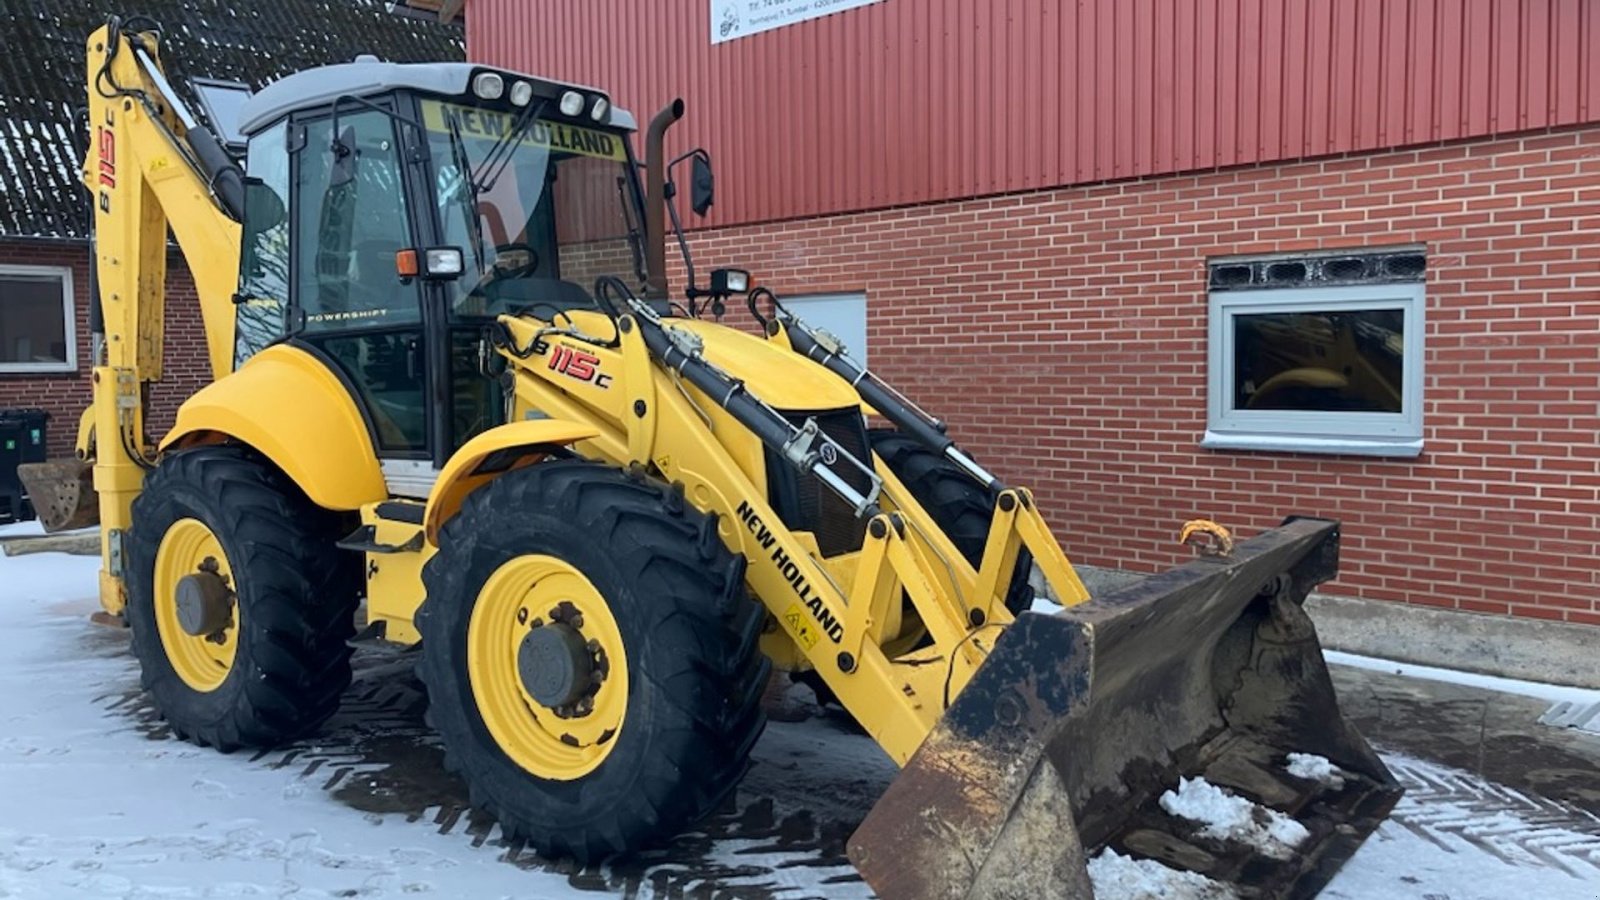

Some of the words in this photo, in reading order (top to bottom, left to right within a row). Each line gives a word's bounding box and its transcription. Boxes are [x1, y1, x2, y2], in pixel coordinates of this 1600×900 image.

[440, 104, 505, 137] NEW
[307, 308, 388, 322] POWERSHIFT
[736, 500, 777, 550] NEW
[771, 546, 844, 644] HOLLAND
